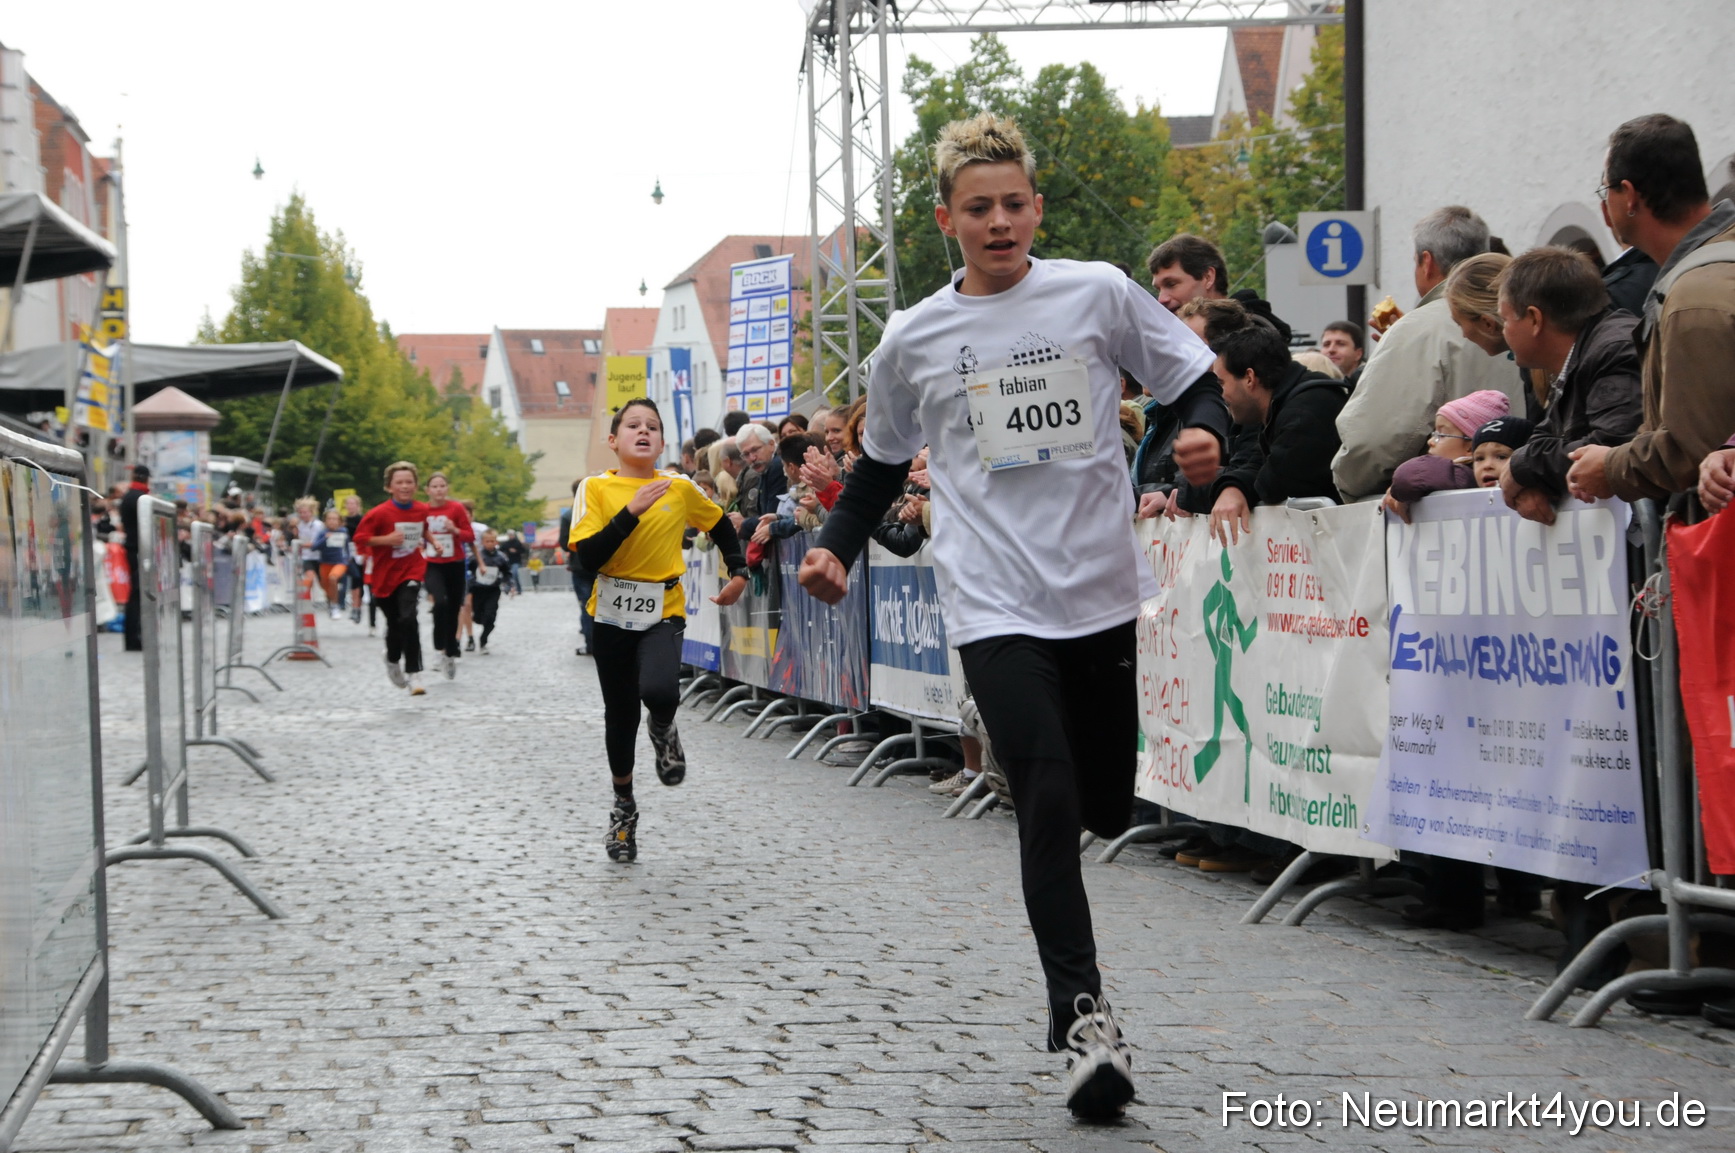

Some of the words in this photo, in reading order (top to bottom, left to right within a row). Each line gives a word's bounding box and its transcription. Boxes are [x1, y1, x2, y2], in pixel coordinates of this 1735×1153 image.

[608, 372, 645, 383] Jugend-
[618, 384, 636, 392] lauf
[999, 376, 1047, 396] fabian
[977, 411, 984, 426] J
[1006, 399, 1082, 433] 4003
[1051, 441, 1093, 455] PFLEIDERER
[614, 578, 638, 592] Samy
[612, 595, 656, 613] 4129
[1412, 712, 1432, 735] Weg
[1392, 735, 1437, 756] Neumarkt
[1430, 820, 1445, 834] von
